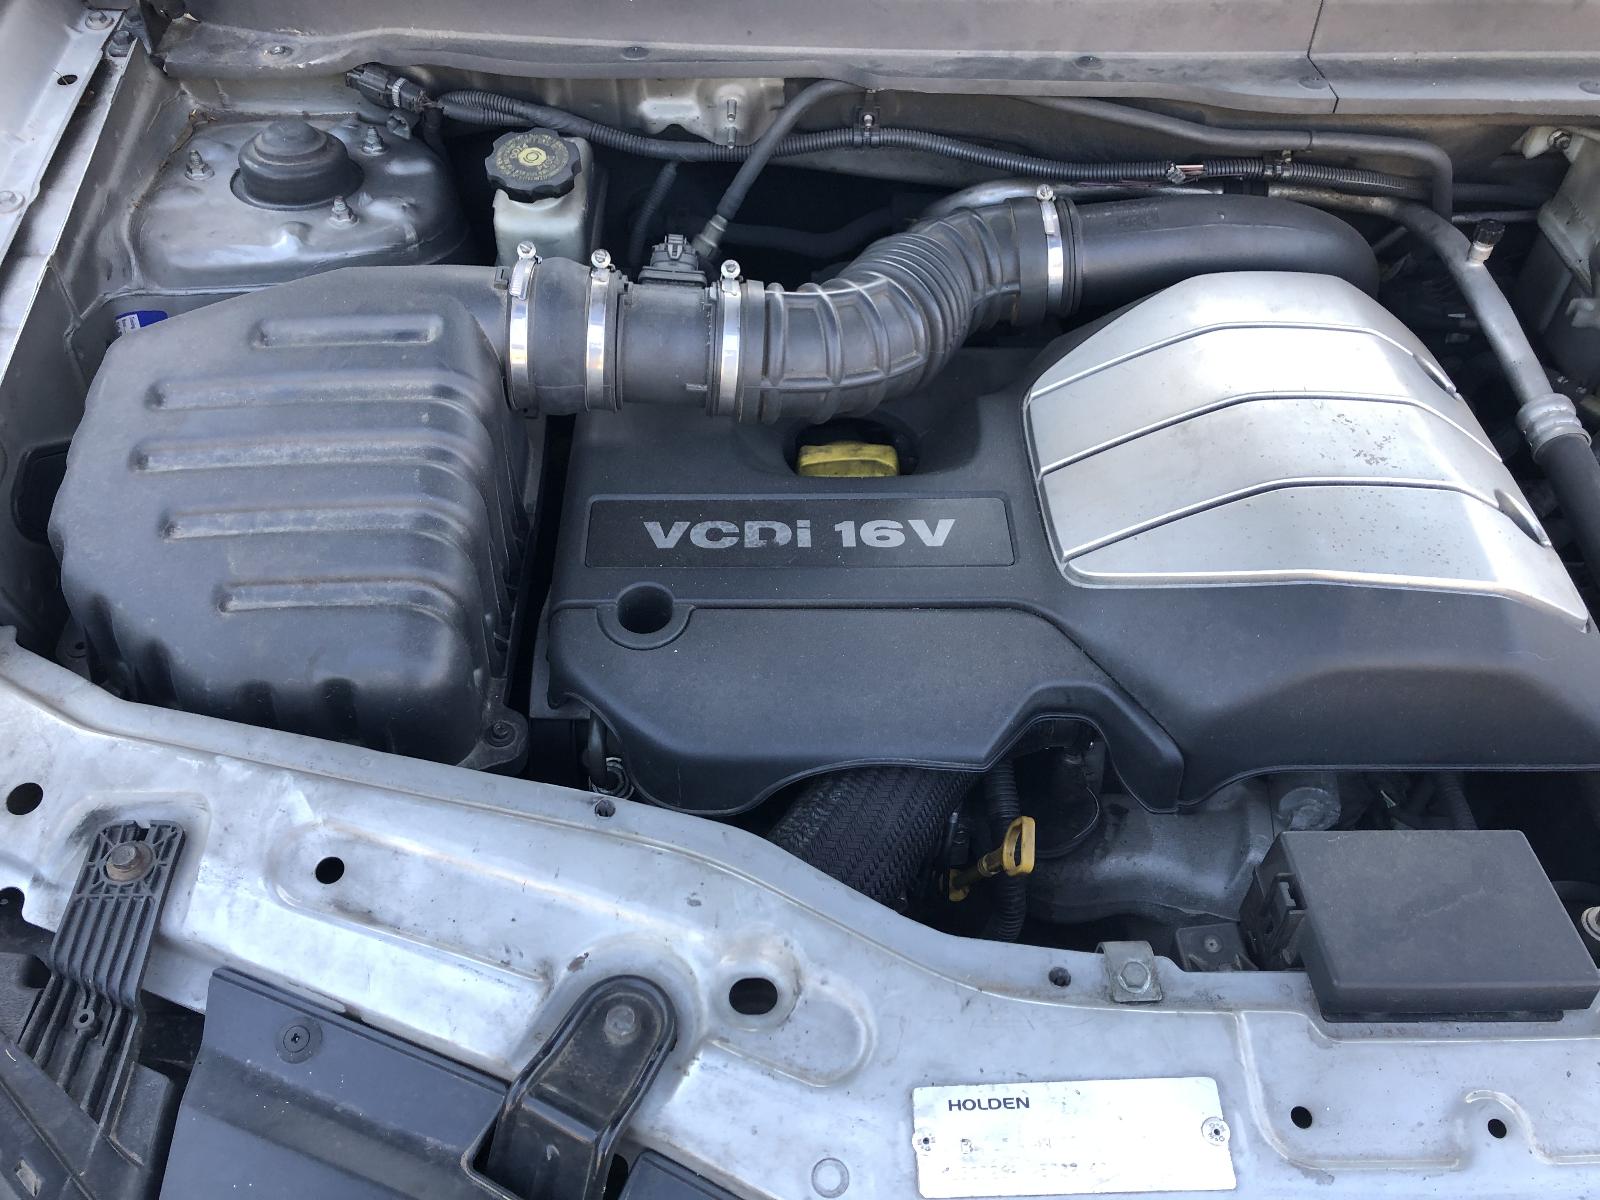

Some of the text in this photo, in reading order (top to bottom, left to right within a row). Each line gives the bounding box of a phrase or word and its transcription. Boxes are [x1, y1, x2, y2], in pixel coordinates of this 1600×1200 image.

[643, 518, 956, 548] VCDi 16V
[948, 1096, 1030, 1112] HOLDEN
